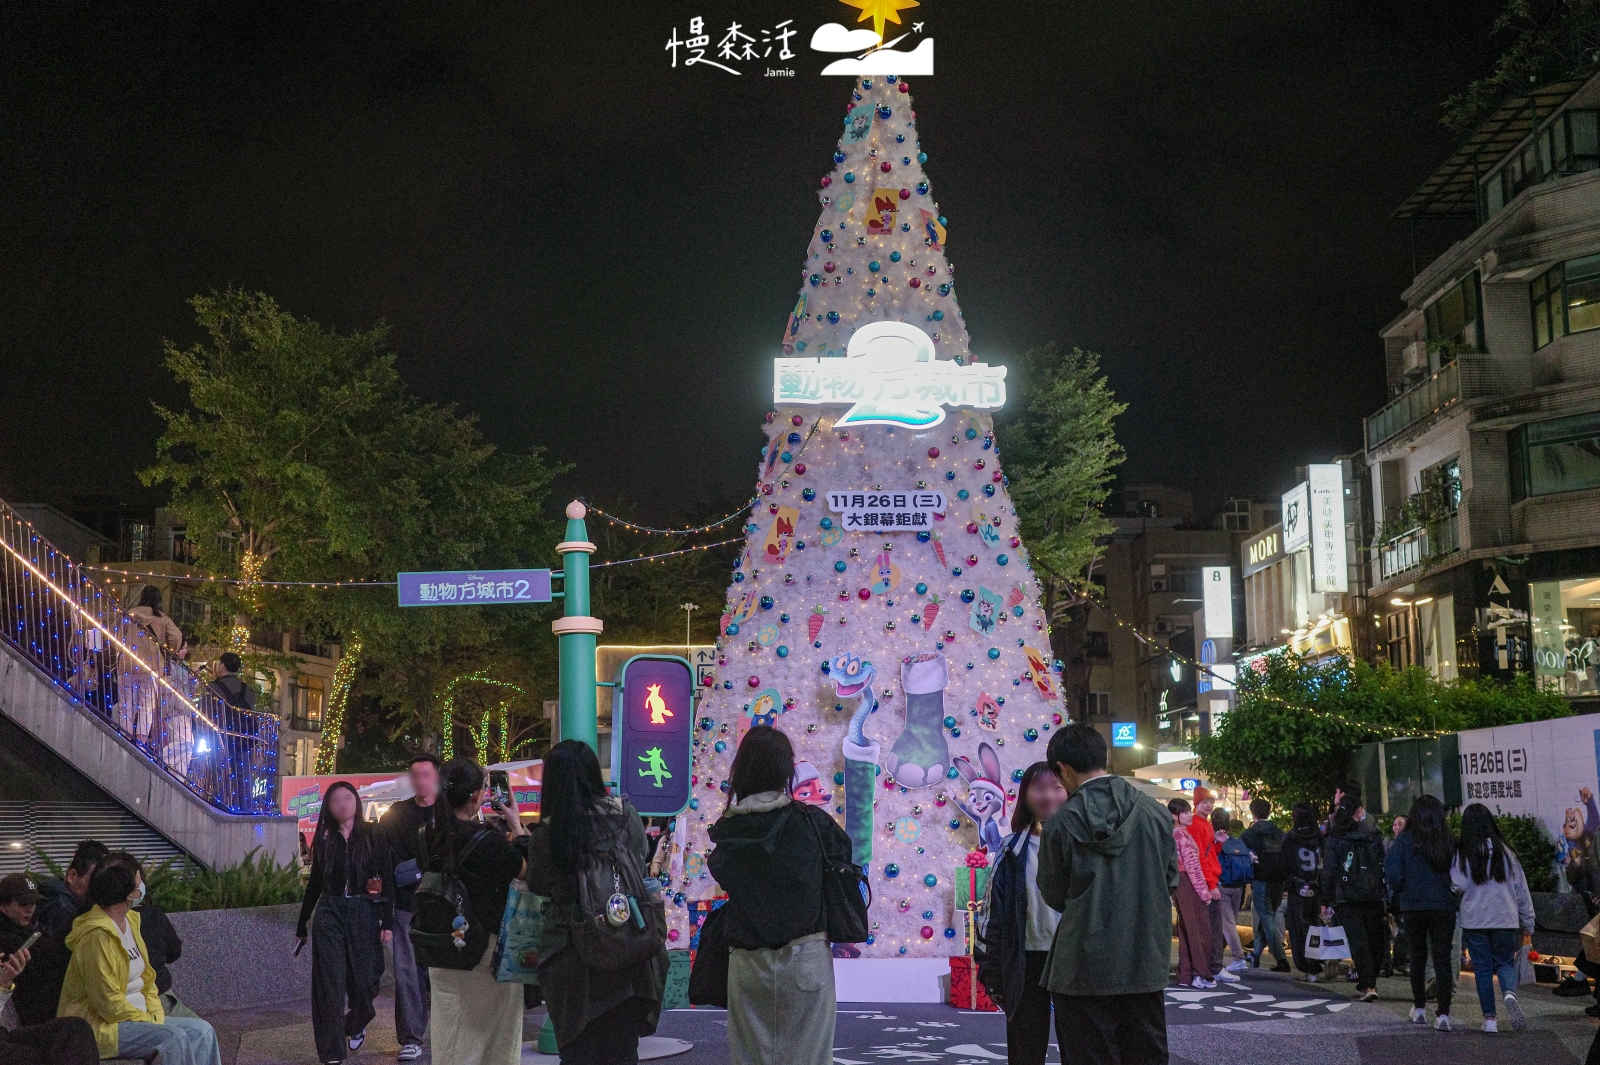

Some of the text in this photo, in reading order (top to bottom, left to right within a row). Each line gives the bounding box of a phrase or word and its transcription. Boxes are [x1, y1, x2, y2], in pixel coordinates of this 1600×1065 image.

[847, 512, 928, 526] 大銀幕鉅獻
[1250, 533, 1277, 565] MORI
[419, 579, 532, 601] 動物方城市2
[1467, 780, 1522, 799] 歡迎您再度光臨
